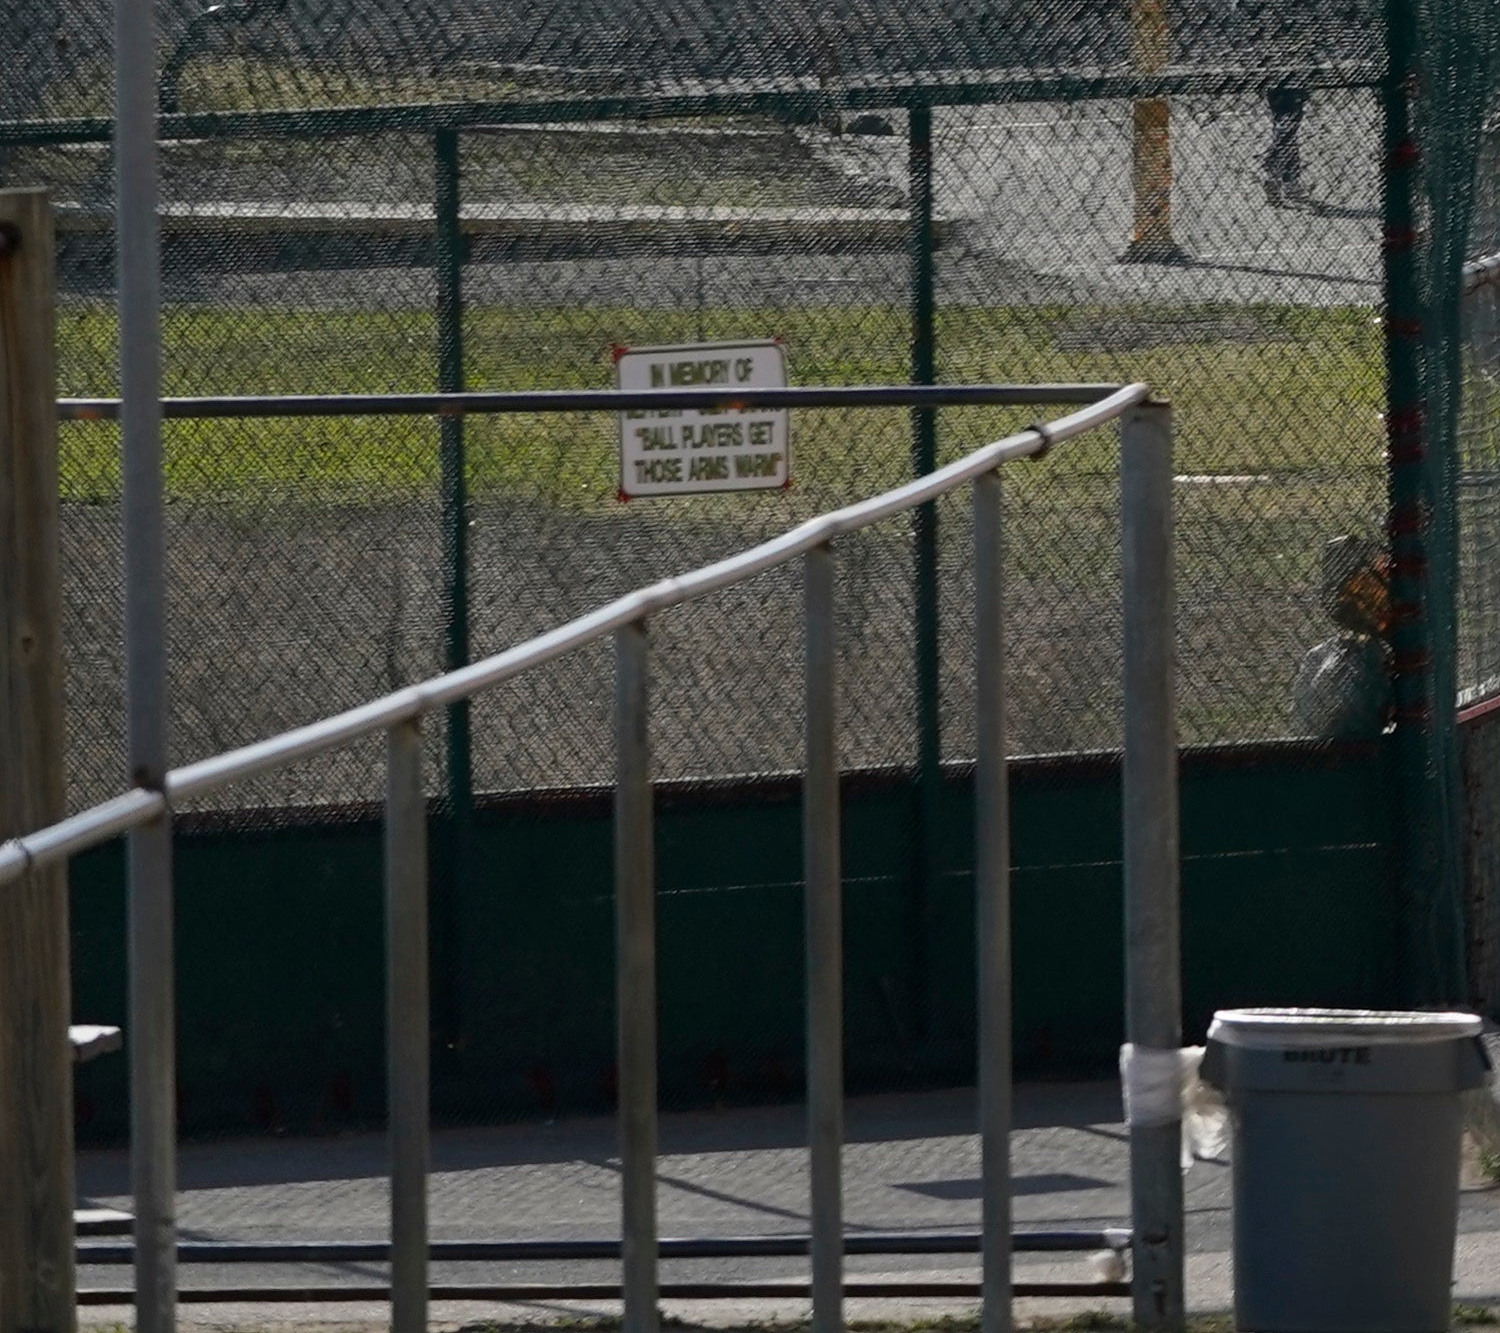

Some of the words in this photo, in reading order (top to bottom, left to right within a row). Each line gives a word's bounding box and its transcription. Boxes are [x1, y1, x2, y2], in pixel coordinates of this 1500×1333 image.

[650, 364, 664, 387] IN
[670, 360, 730, 385] MEMORY
[735, 357, 753, 382] OF
[682, 424, 743, 449] PLAYERS
[749, 421, 775, 446] GET
[634, 459, 682, 483] THOSE
[688, 456, 729, 482] ARMS
[1284, 1047, 1370, 1064] BRUTE
